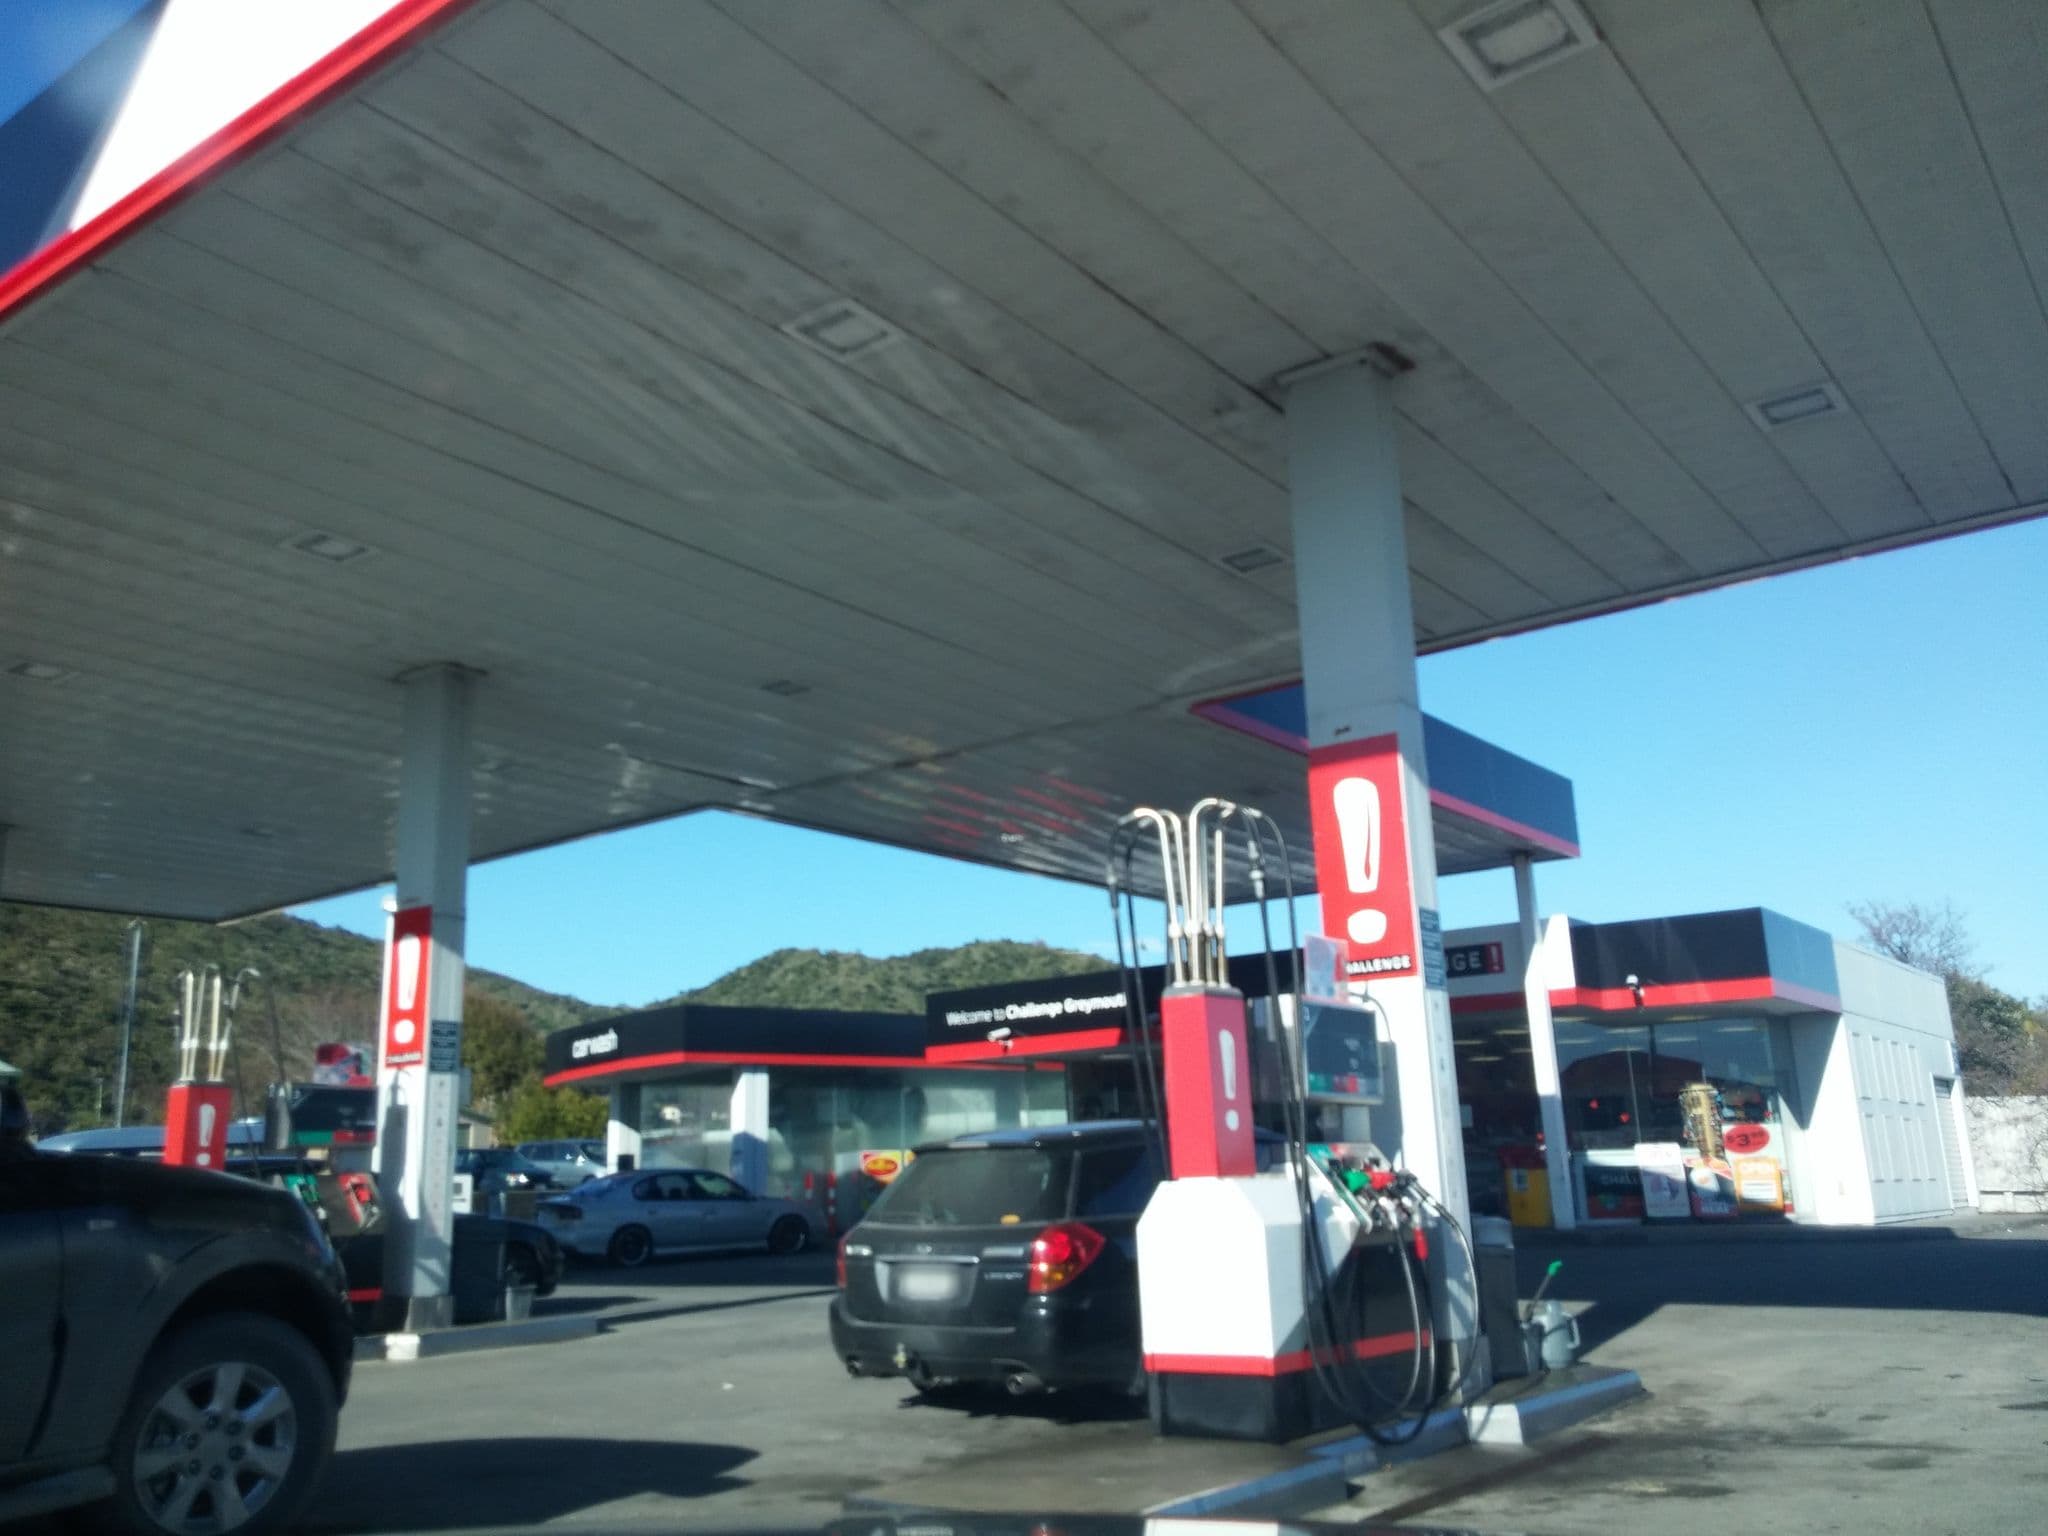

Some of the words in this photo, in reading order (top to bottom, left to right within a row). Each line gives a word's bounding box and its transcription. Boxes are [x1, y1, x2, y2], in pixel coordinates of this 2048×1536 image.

[946, 1010, 993, 1026] Welcome
[994, 1008, 1006, 1021] to
[1005, 1002, 1063, 1020] Challenge
[572, 1028, 618, 1058] carwash
